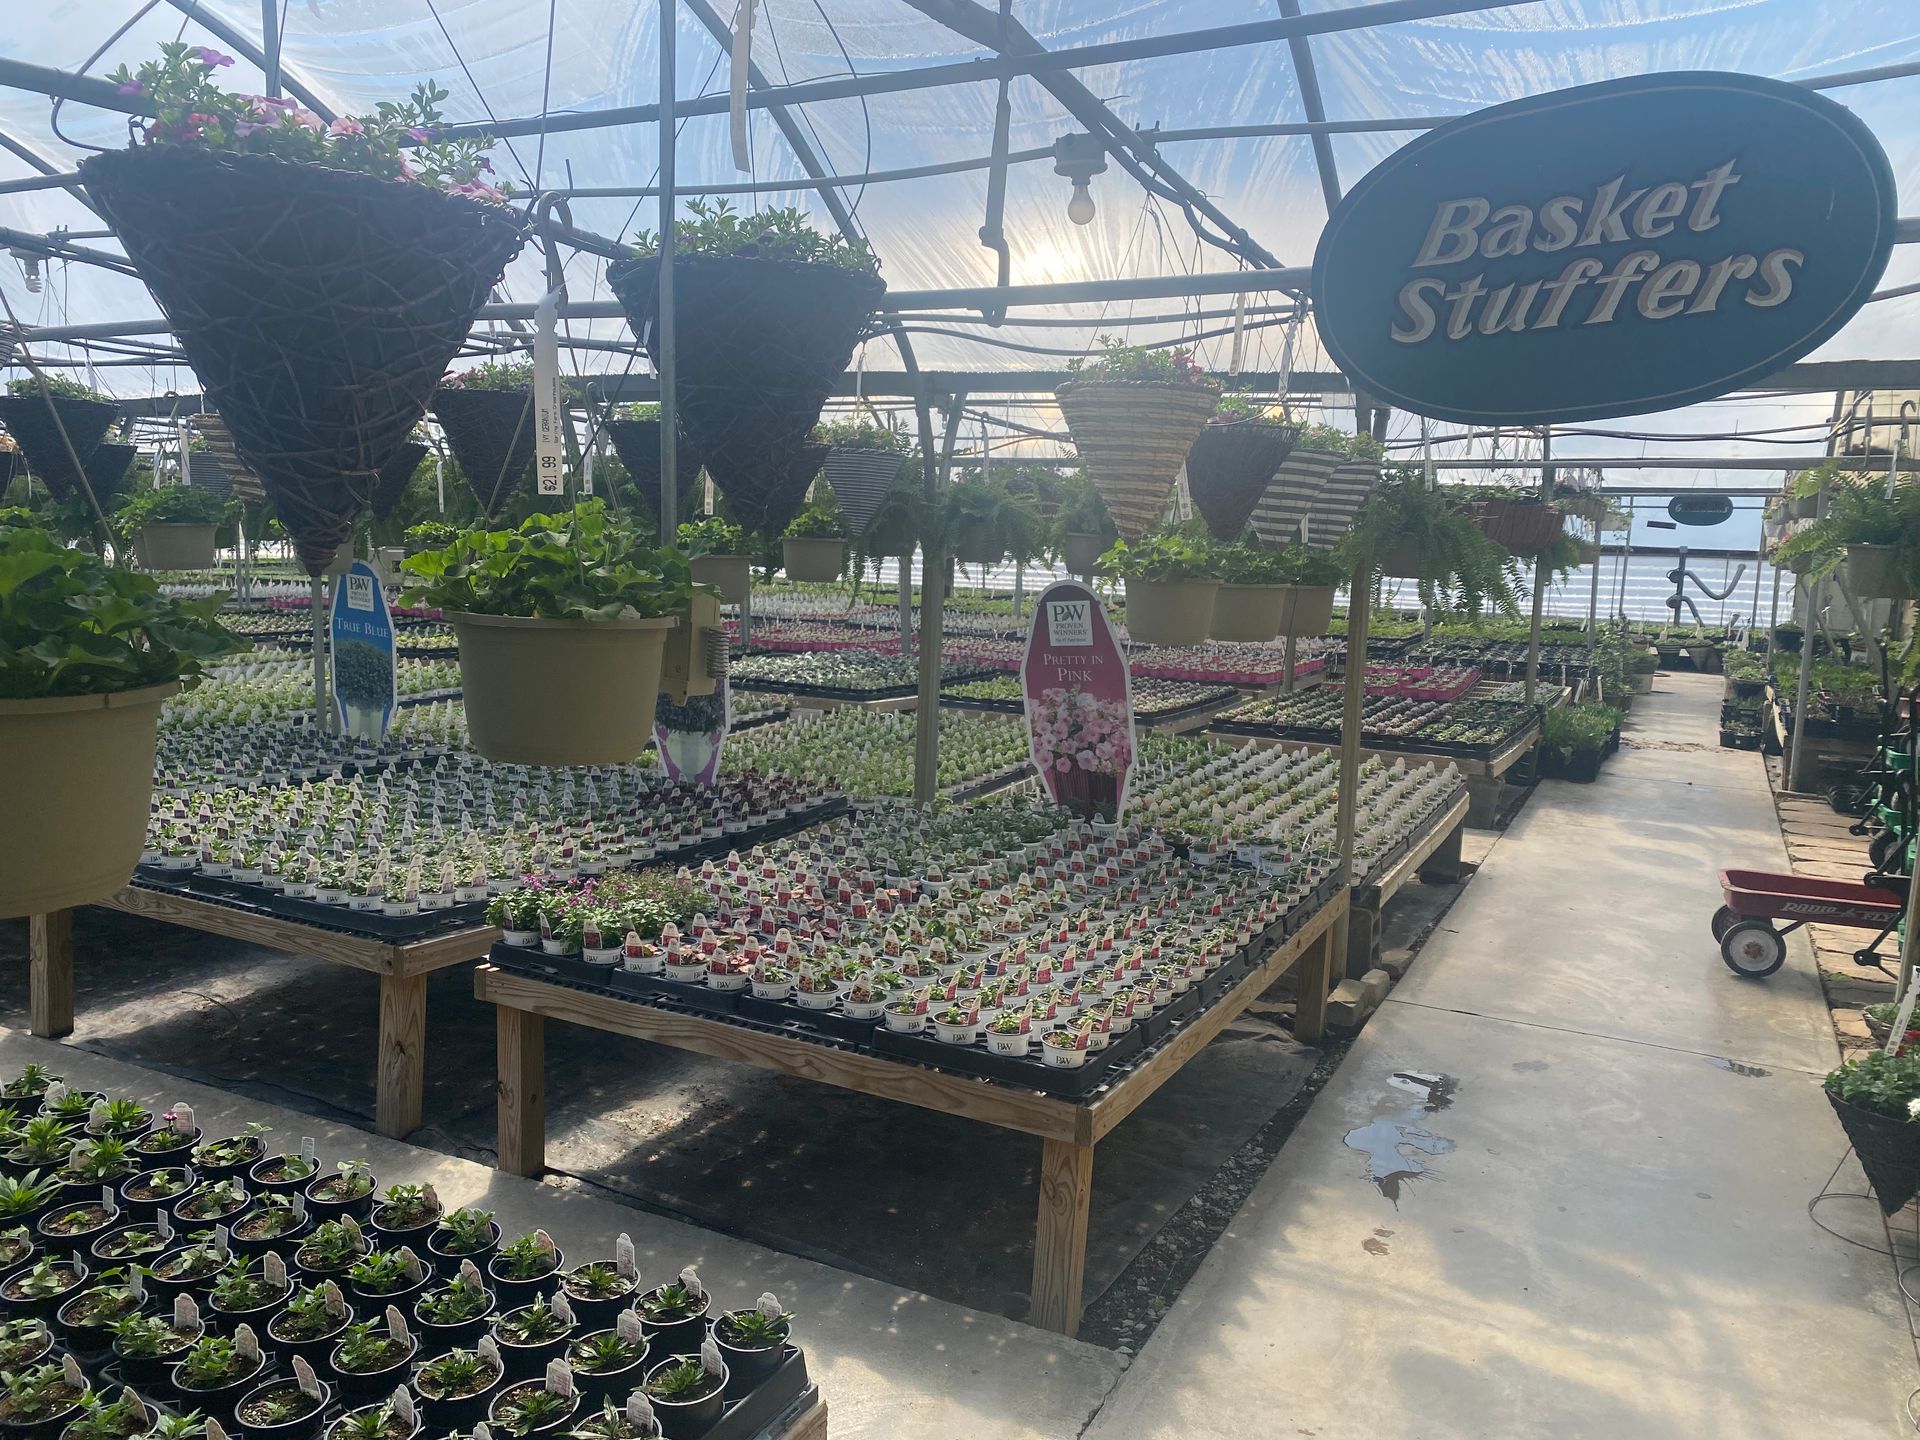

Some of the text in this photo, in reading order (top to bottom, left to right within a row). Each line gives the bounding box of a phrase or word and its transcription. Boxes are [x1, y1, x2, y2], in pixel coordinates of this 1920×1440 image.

[1409, 158, 1742, 269] Basket
[1390, 247, 1806, 344] Stuffers
[541, 456, 557, 492] $21.99
[335, 617, 390, 638] TRUE BLUE
[1043, 653, 1104, 665] PRETTY IN
[1057, 667, 1093, 682] PINK
[1781, 902, 1837, 913] RADIO
